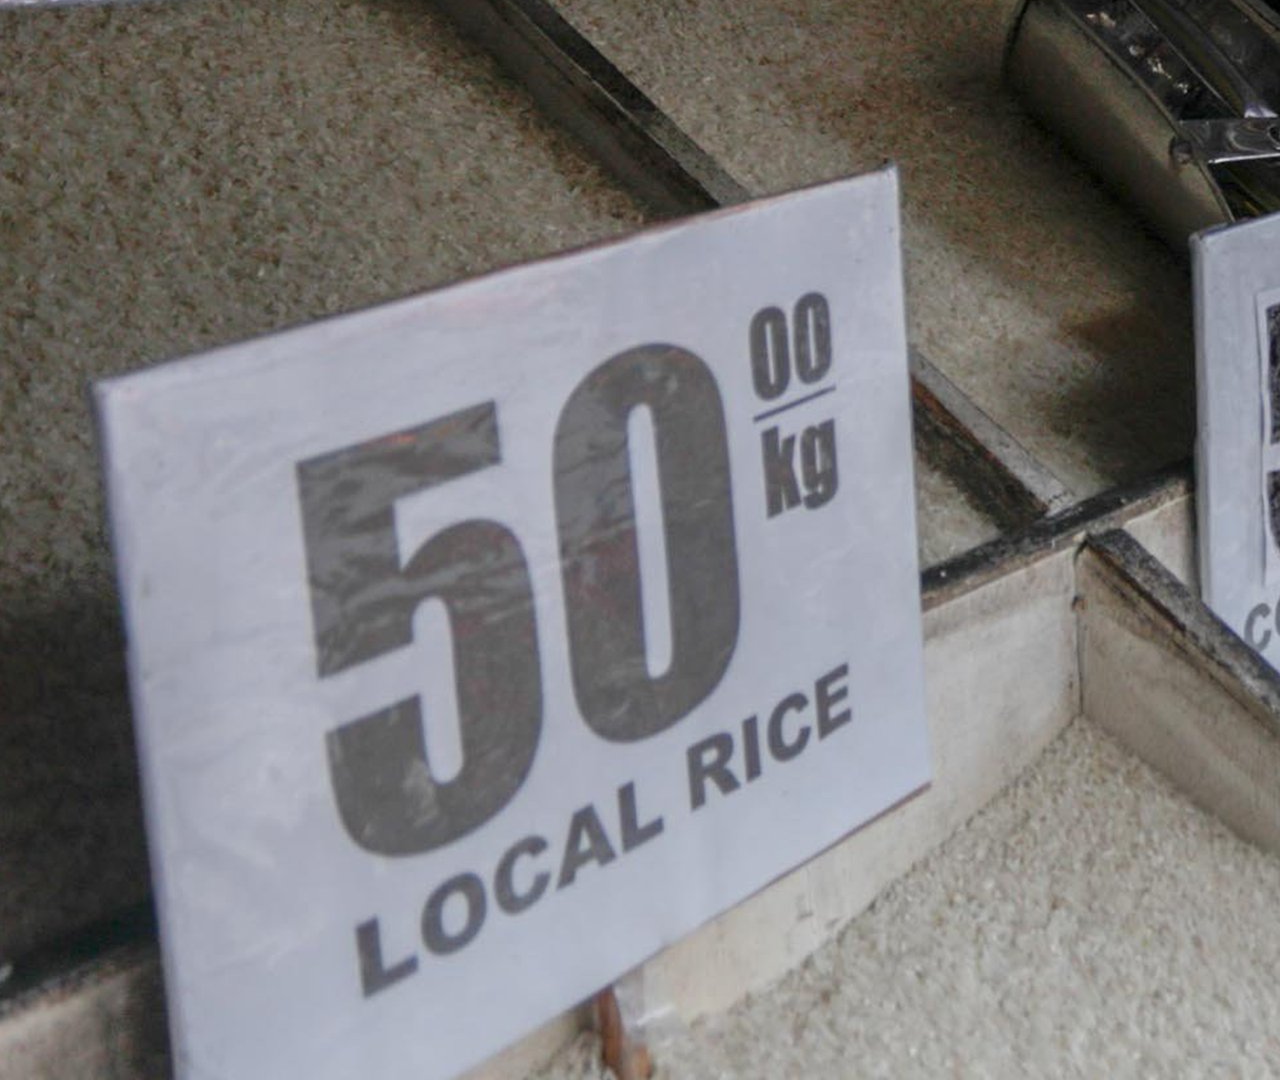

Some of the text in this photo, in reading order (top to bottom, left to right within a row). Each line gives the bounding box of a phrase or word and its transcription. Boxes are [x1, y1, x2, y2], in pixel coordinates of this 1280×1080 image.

[748, 291, 834, 402] 00
[759, 418, 840, 519] kg
[295, 342, 741, 858] 50
[354, 662, 854, 1000] LOCAL RICE
